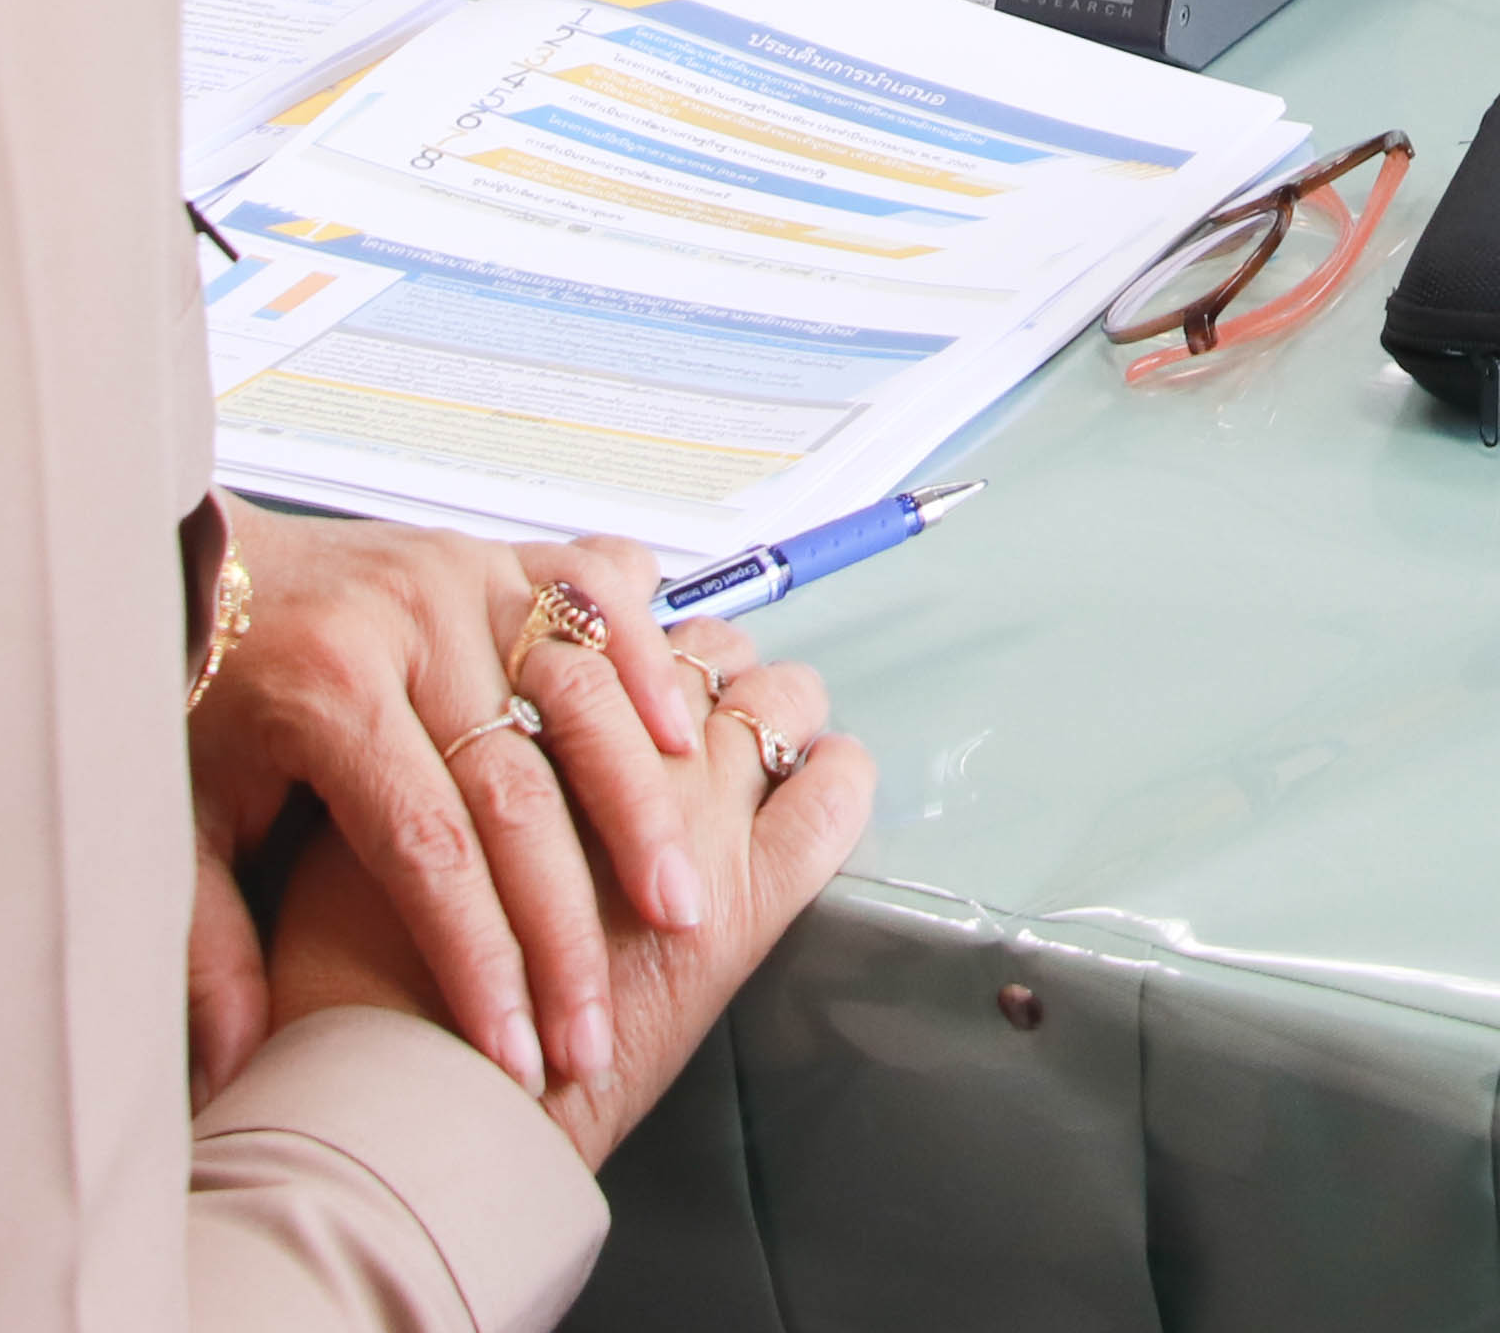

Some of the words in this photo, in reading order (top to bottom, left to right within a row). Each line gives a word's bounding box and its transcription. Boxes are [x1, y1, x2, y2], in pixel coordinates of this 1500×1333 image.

[747, 32, 947, 108] ประเด็นการนำเสนอ
[410, 148, 443, 171] 8
[721, 562, 761, 586] Expert
